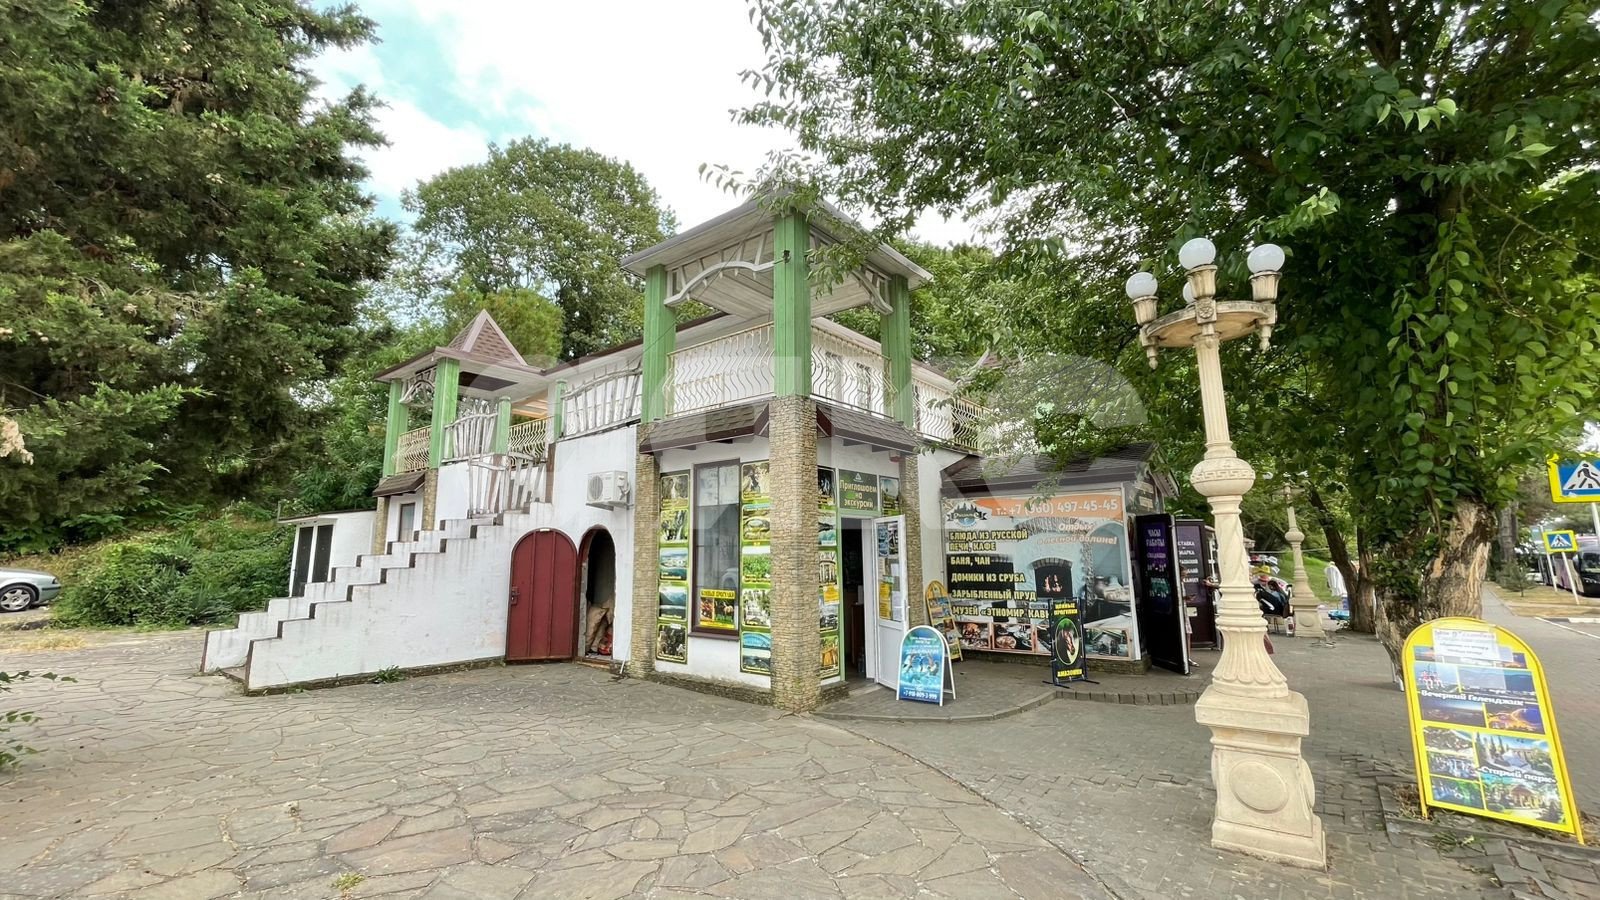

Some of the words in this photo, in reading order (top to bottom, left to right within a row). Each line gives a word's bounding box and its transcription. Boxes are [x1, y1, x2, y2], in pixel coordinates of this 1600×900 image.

[840, 480, 877, 493] Приглашаем
[1057, 499, 1118, 513] 497-45-45
[1059, 522, 1093, 532] Отдых
[949, 531, 977, 541] БЛЮДА
[979, 531, 989, 540] ИЗ
[991, 528, 1029, 540] РУССКОЙ
[1079, 534, 1118, 545] долине!
[973, 541, 996, 551] КАФЕ
[950, 556, 973, 567] БАНЯ,
[974, 556, 991, 565] ЧАН
[951, 573, 985, 583] ДОМИКИ
[986, 573, 997, 582] ИЗ
[998, 573, 1025, 583] СРУБА
[951, 589, 1012, 600] ЗАРЫБЛЕННЫЙ
[1014, 590, 1037, 602] ПРУД
[951, 605, 979, 616] МУЗЕЙ
[1421, 690, 1466, 701] Вечерний
[1468, 693, 1524, 707] Геленджик
[1482, 766, 1522, 780] Старый
